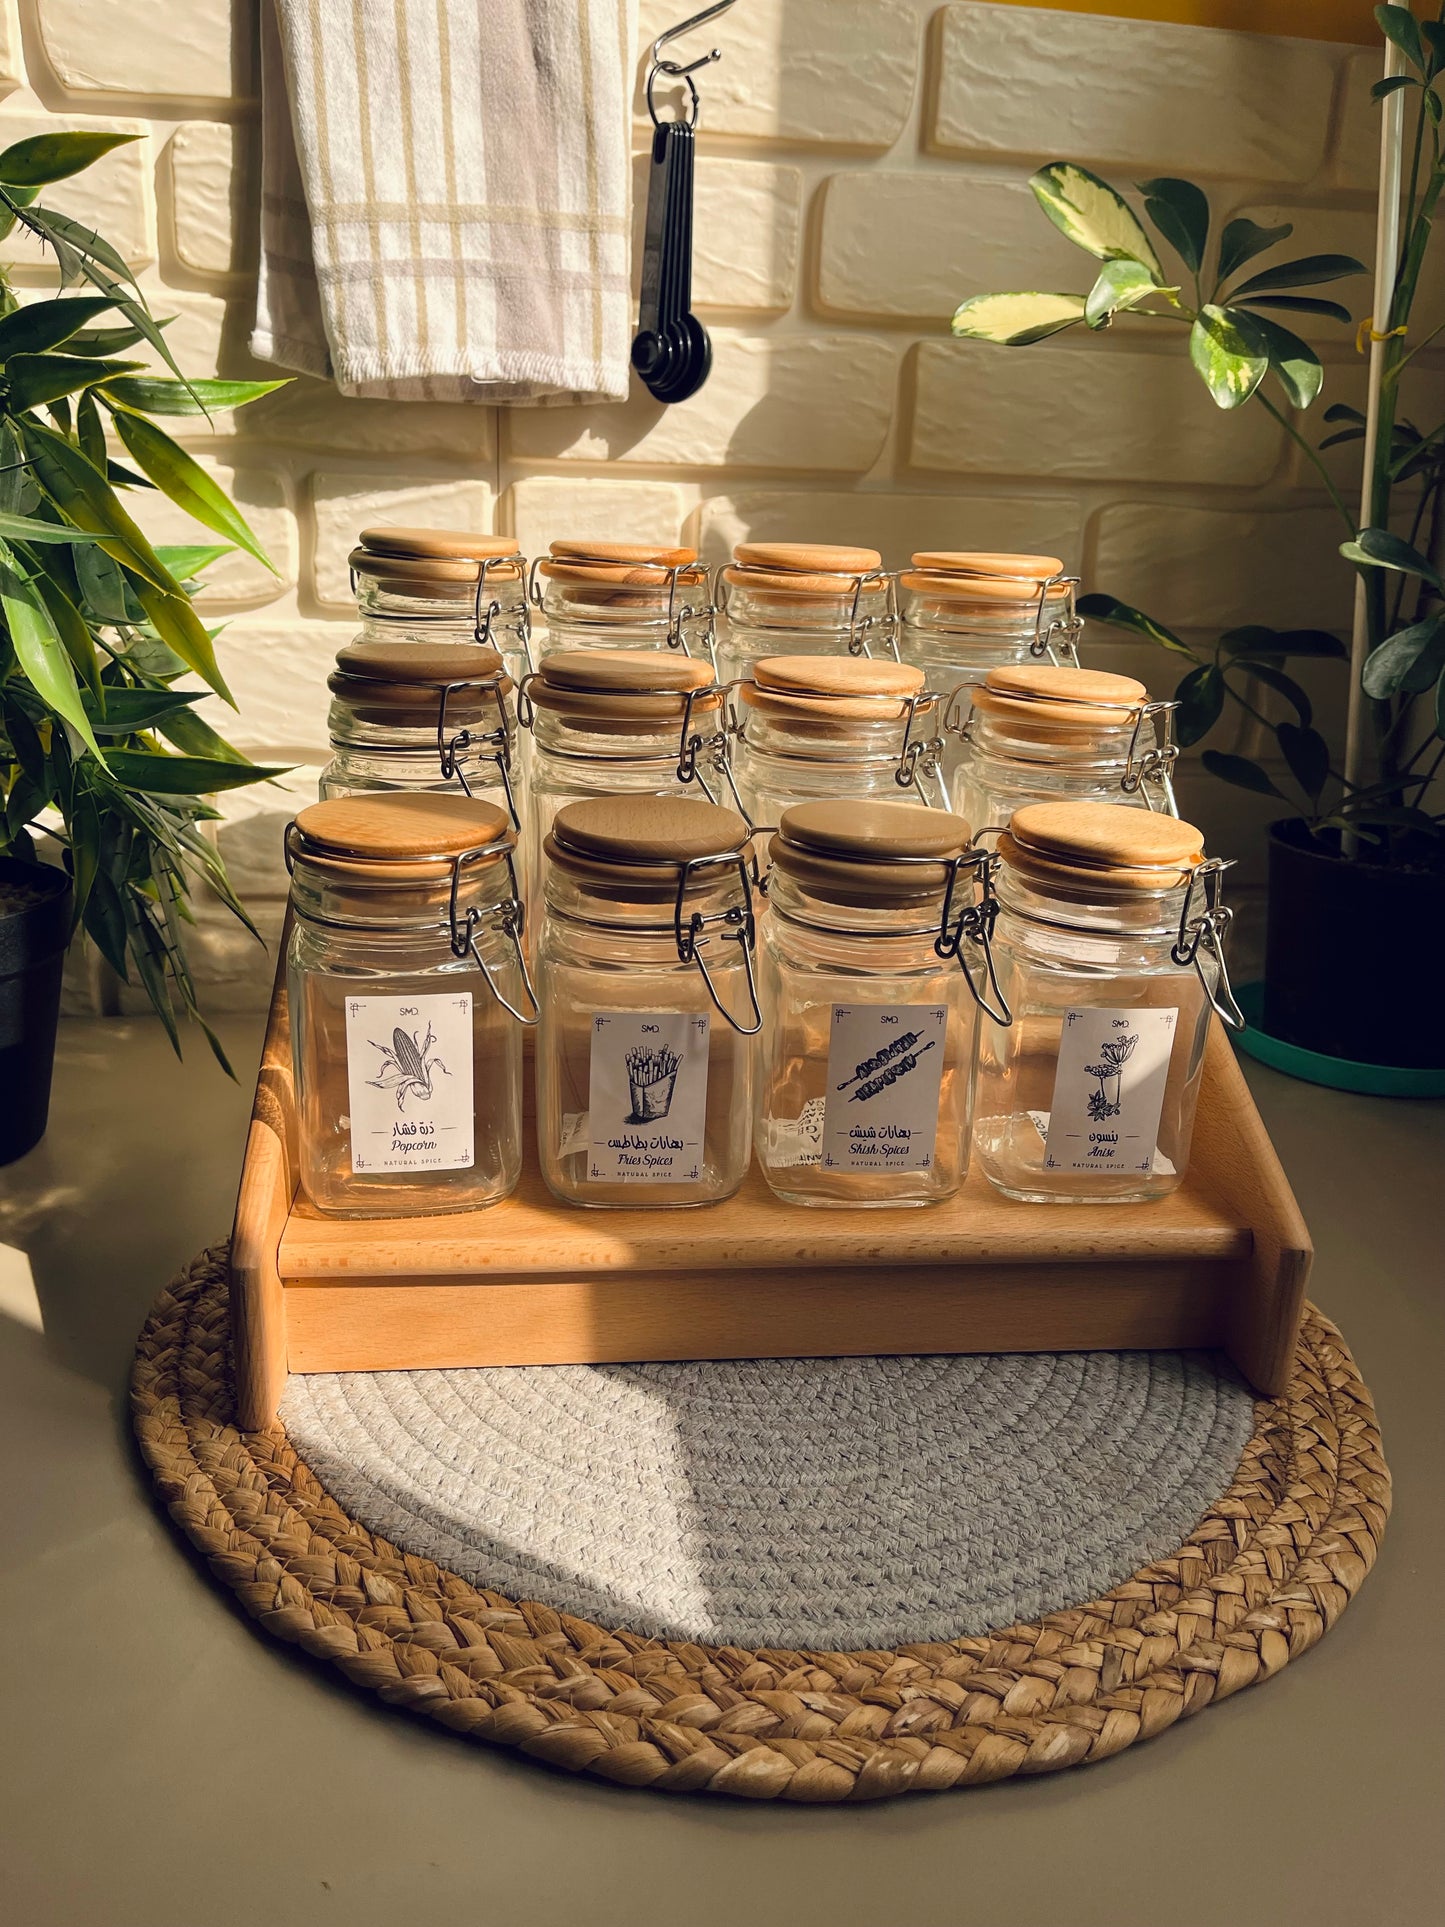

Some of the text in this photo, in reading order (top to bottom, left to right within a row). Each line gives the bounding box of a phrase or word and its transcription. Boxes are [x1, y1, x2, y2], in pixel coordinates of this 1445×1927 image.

[392, 1121, 435, 1137] ذرة فشار
[849, 1124, 911, 1141] بهارات شيش
[607, 1134, 684, 1151] بهارات بطاطس
[1088, 1130, 1119, 1144] ينسون
[391, 1139, 437, 1154] Popcorn
[848, 1143, 910, 1158] Shish Spices
[1087, 1145, 1116, 1157] Anise
[617, 1153, 673, 1168] Fries Spices
